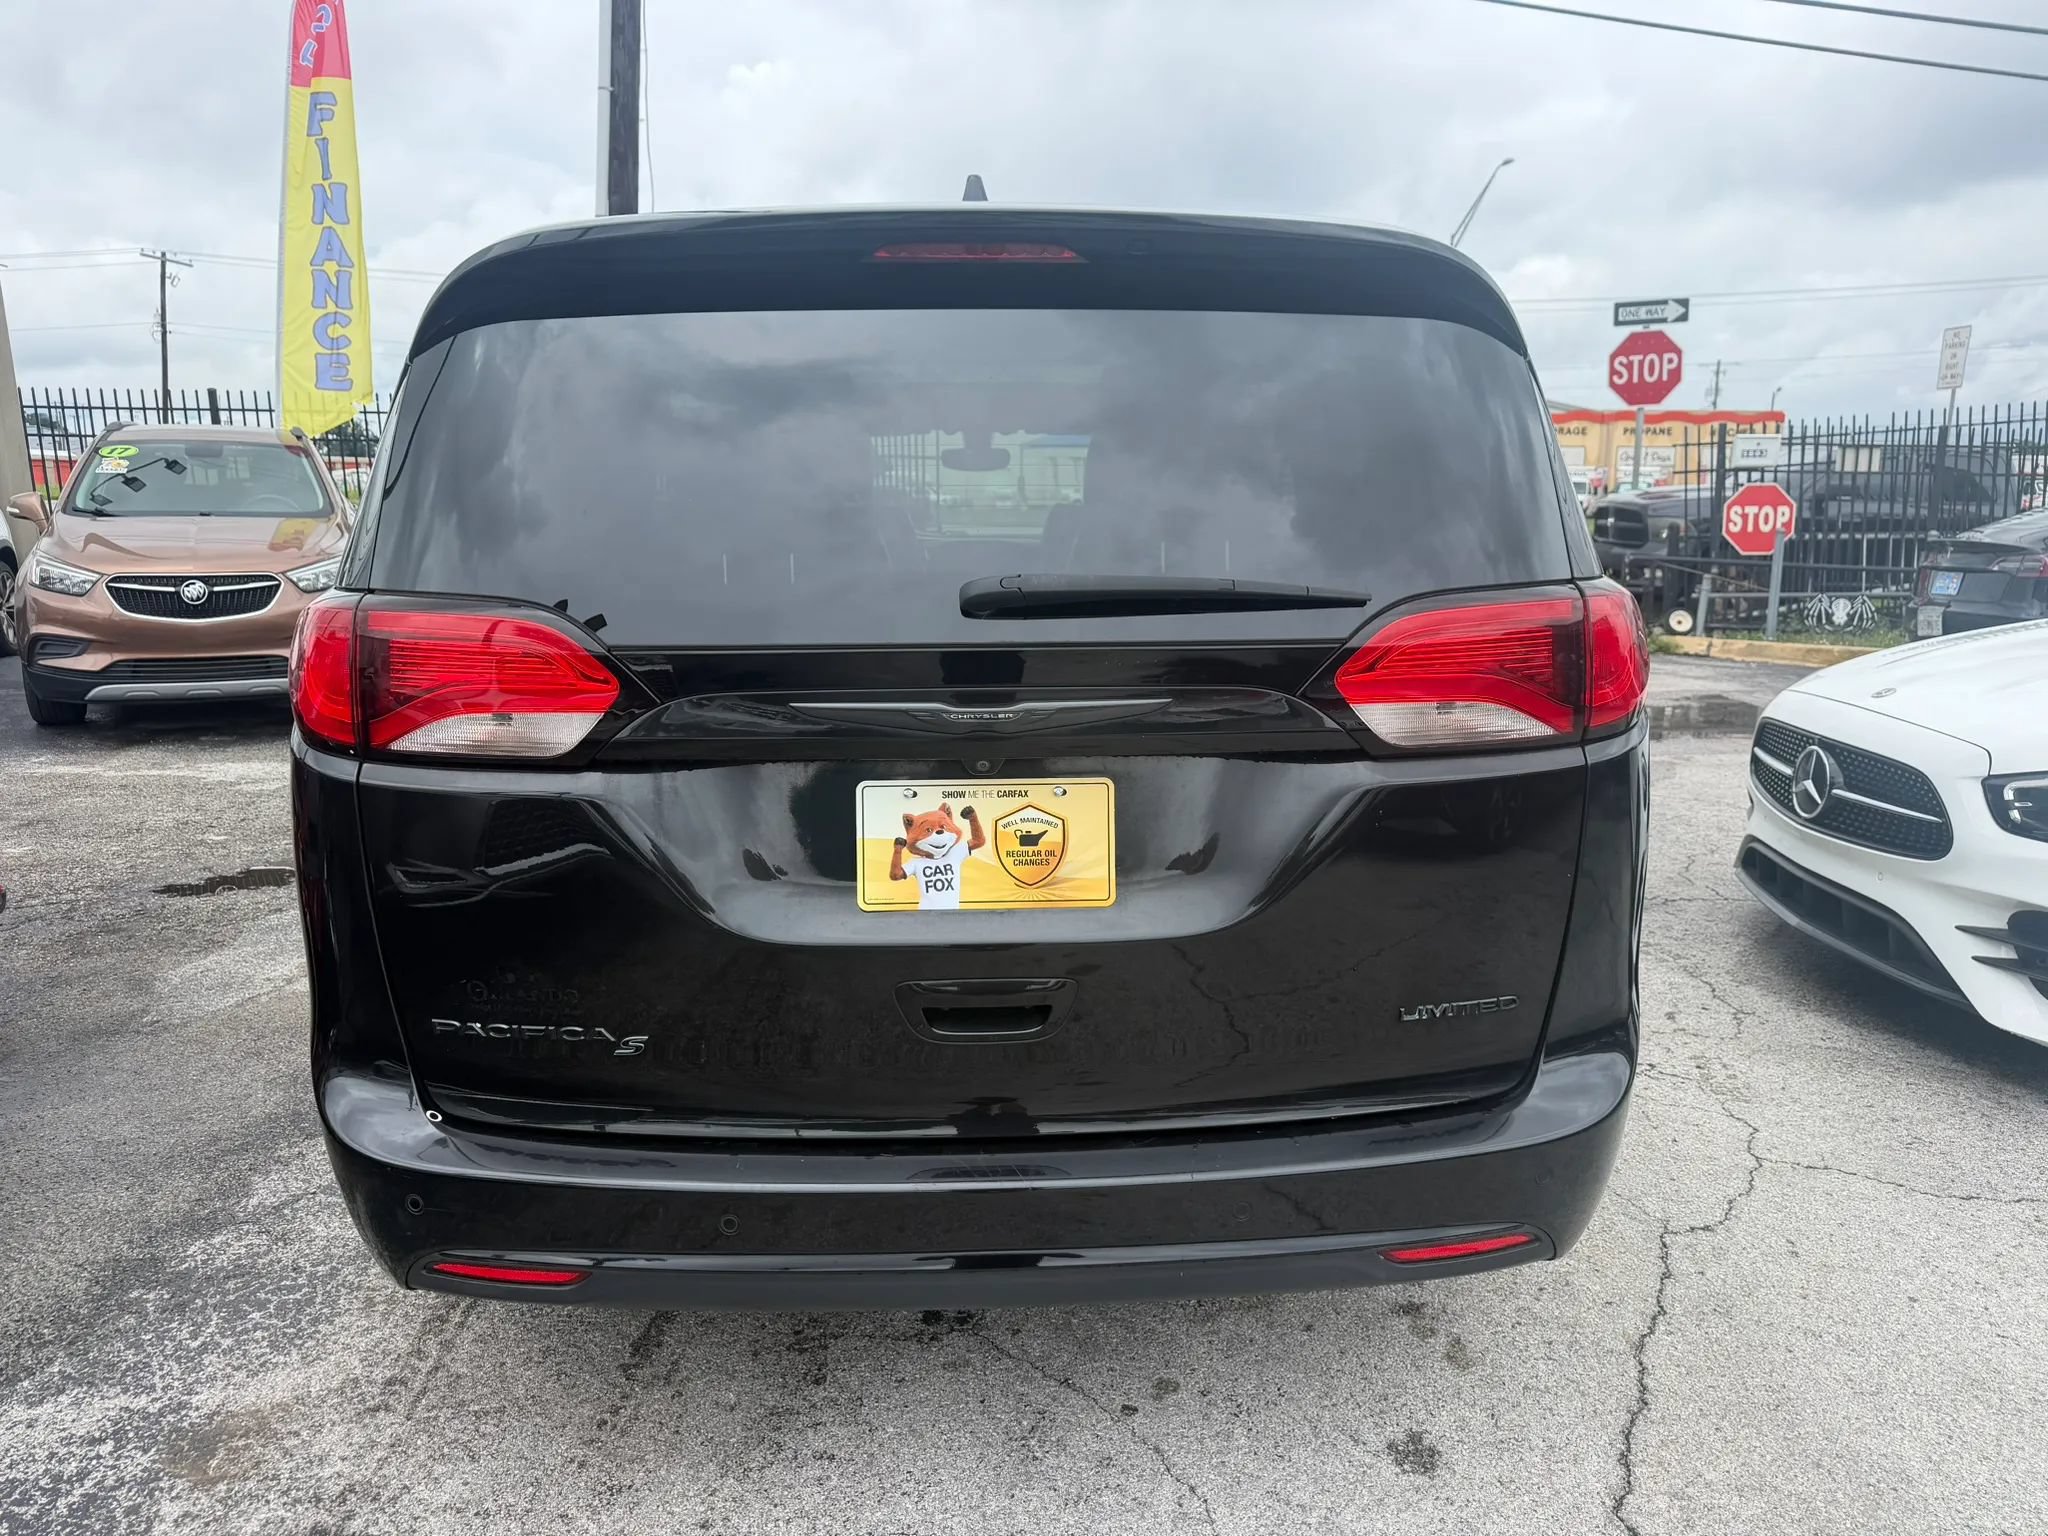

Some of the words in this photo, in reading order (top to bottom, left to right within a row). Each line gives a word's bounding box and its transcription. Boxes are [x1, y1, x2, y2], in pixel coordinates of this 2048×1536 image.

[306, 91, 354, 391] FINANCE
[1621, 307, 1641, 318] ONE
[1646, 305, 1666, 316] WAY
[1612, 352, 1679, 385] STOP
[1623, 426, 1673, 436] PRPANE
[106, 446, 132, 456] 17
[1728, 505, 1791, 533] STOP
[941, 790, 966, 799] SHOW
[968, 790, 979, 798] ME
[981, 789, 995, 798] THE
[997, 789, 1029, 798] CARFAX
[1001, 819, 1019, 829] WELL
[1019, 817, 1059, 829] MAINTAINED
[1006, 850, 1042, 858] REGULAR
[1044, 849, 1058, 857] OIL
[1013, 858, 1050, 867] CHANGES
[922, 863, 954, 879] CAR
[924, 878, 955, 893] FOX
[1399, 995, 1520, 1021] LIMITED
[431, 1018, 616, 1043] PACIFICA
[613, 1035, 649, 1056] S
